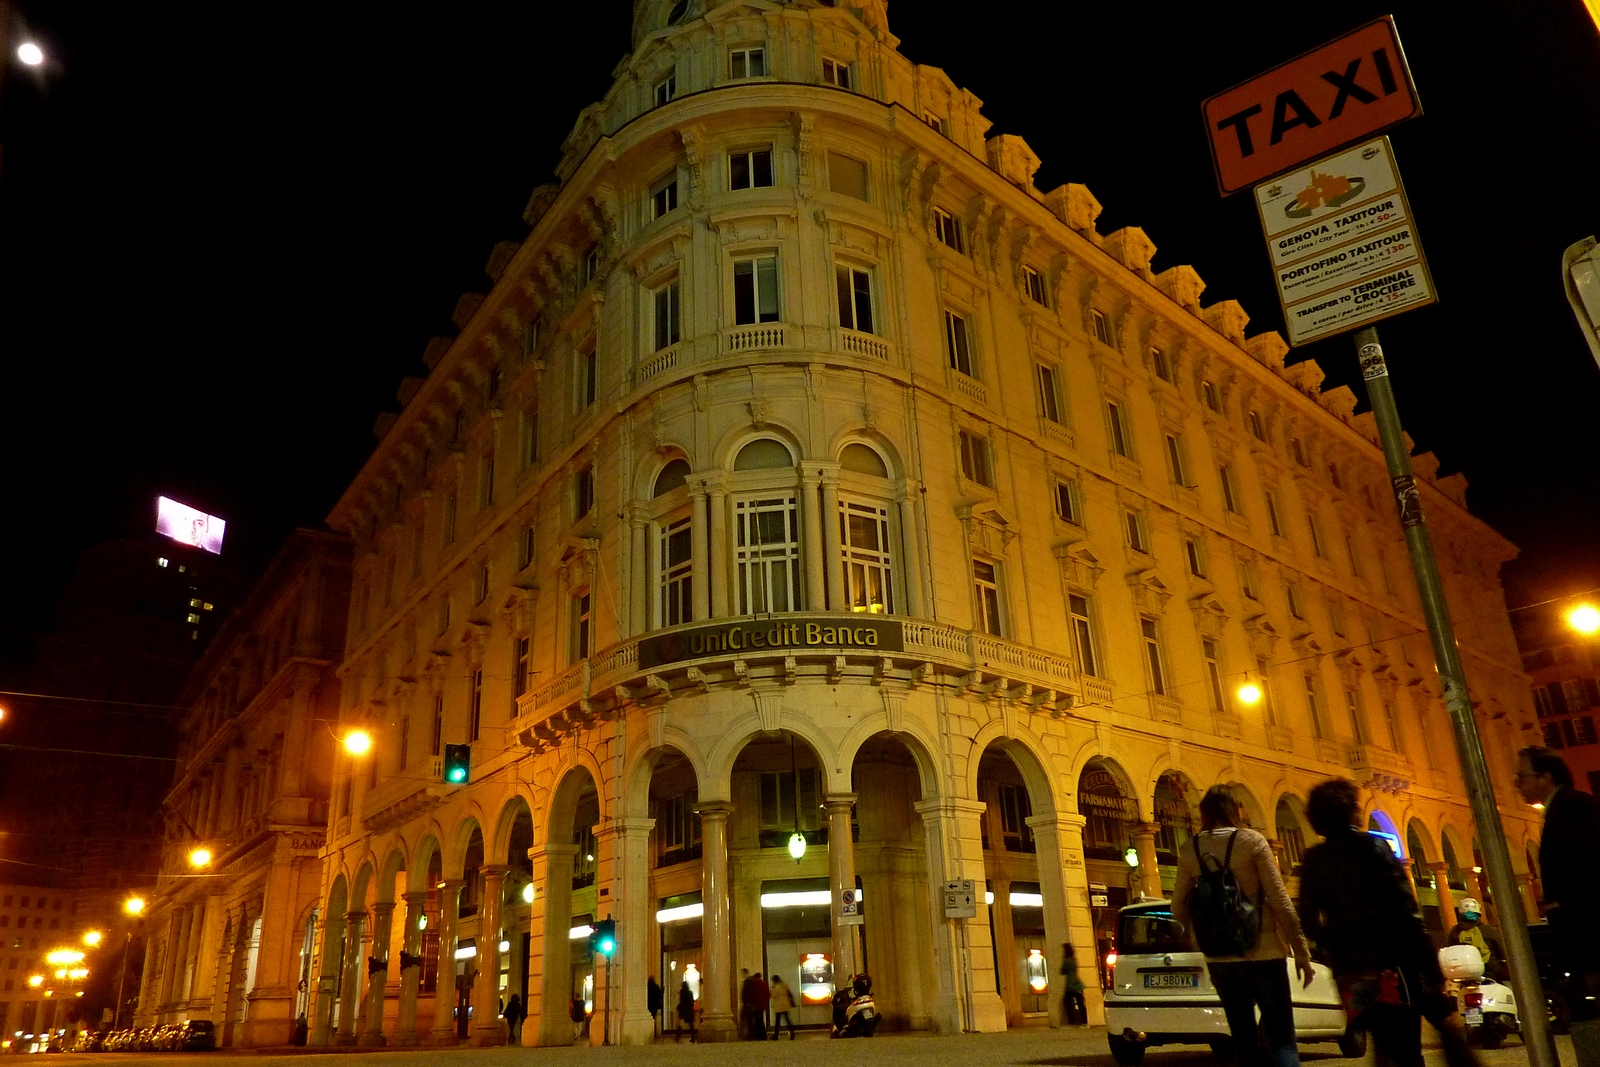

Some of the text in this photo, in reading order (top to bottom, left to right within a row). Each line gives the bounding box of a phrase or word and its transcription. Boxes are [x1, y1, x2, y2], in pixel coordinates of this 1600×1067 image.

[1217, 47, 1398, 158] TAXI
[1279, 225, 1329, 248] GENOVA
[1334, 201, 1394, 228] TAXITOUR
[1281, 248, 1296, 257] Giro
[1319, 235, 1333, 244] City
[1333, 229, 1350, 238] Tour
[1281, 253, 1347, 282] PORTOFINO
[1348, 231, 1410, 257] TAXITOUR
[1350, 270, 1413, 296] TERMINAL
[1354, 277, 1416, 304] CROCIERE
[1296, 295, 1351, 317] TRANSFER TO
[1355, 302, 1374, 311] drive
[690, 621, 879, 655] UniCredit Banca
[1150, 975, 1160, 986] EJ
